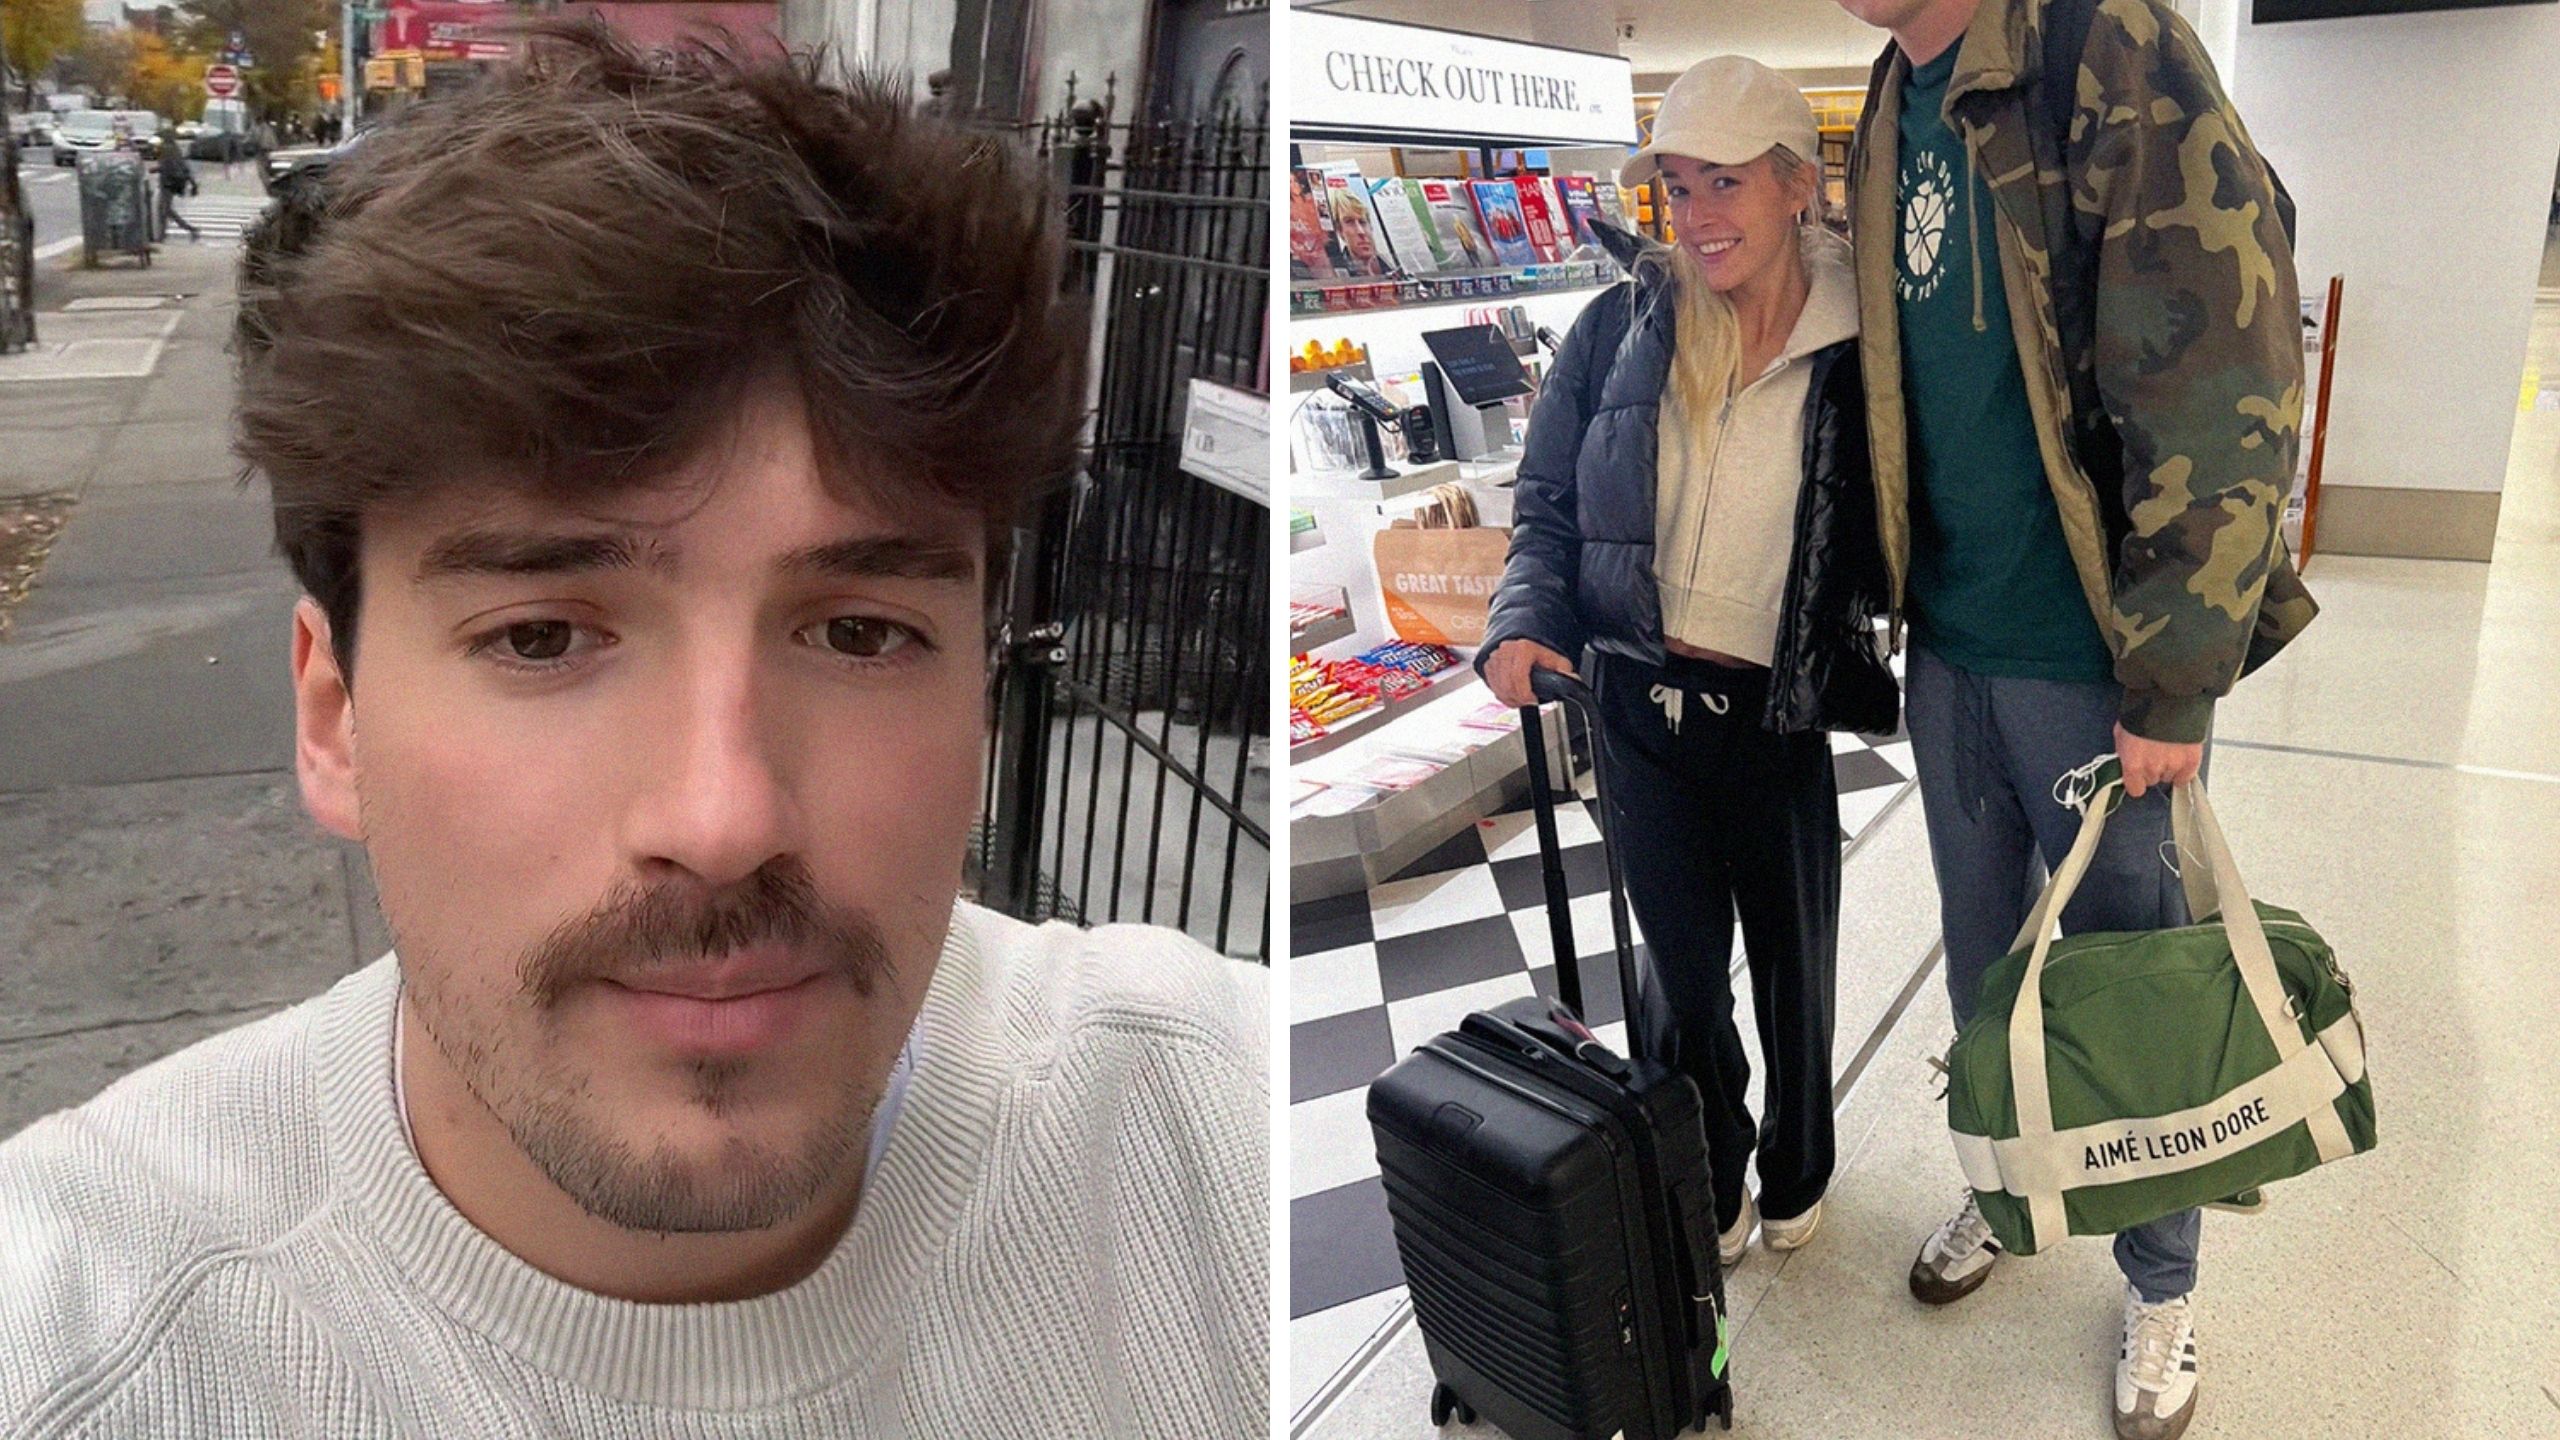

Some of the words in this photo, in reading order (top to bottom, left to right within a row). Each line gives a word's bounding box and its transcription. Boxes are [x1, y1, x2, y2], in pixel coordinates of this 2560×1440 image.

[1326, 50, 1439, 98] CHECK
[1444, 63, 1504, 105] OUT
[1511, 73, 1580, 112] HERE
[1395, 573, 1447, 594] GREAT
[2084, 1130, 2141, 1170] AIMÉ
[2145, 1126, 2207, 1159] LEON
[2211, 1097, 2270, 1144] DORE
